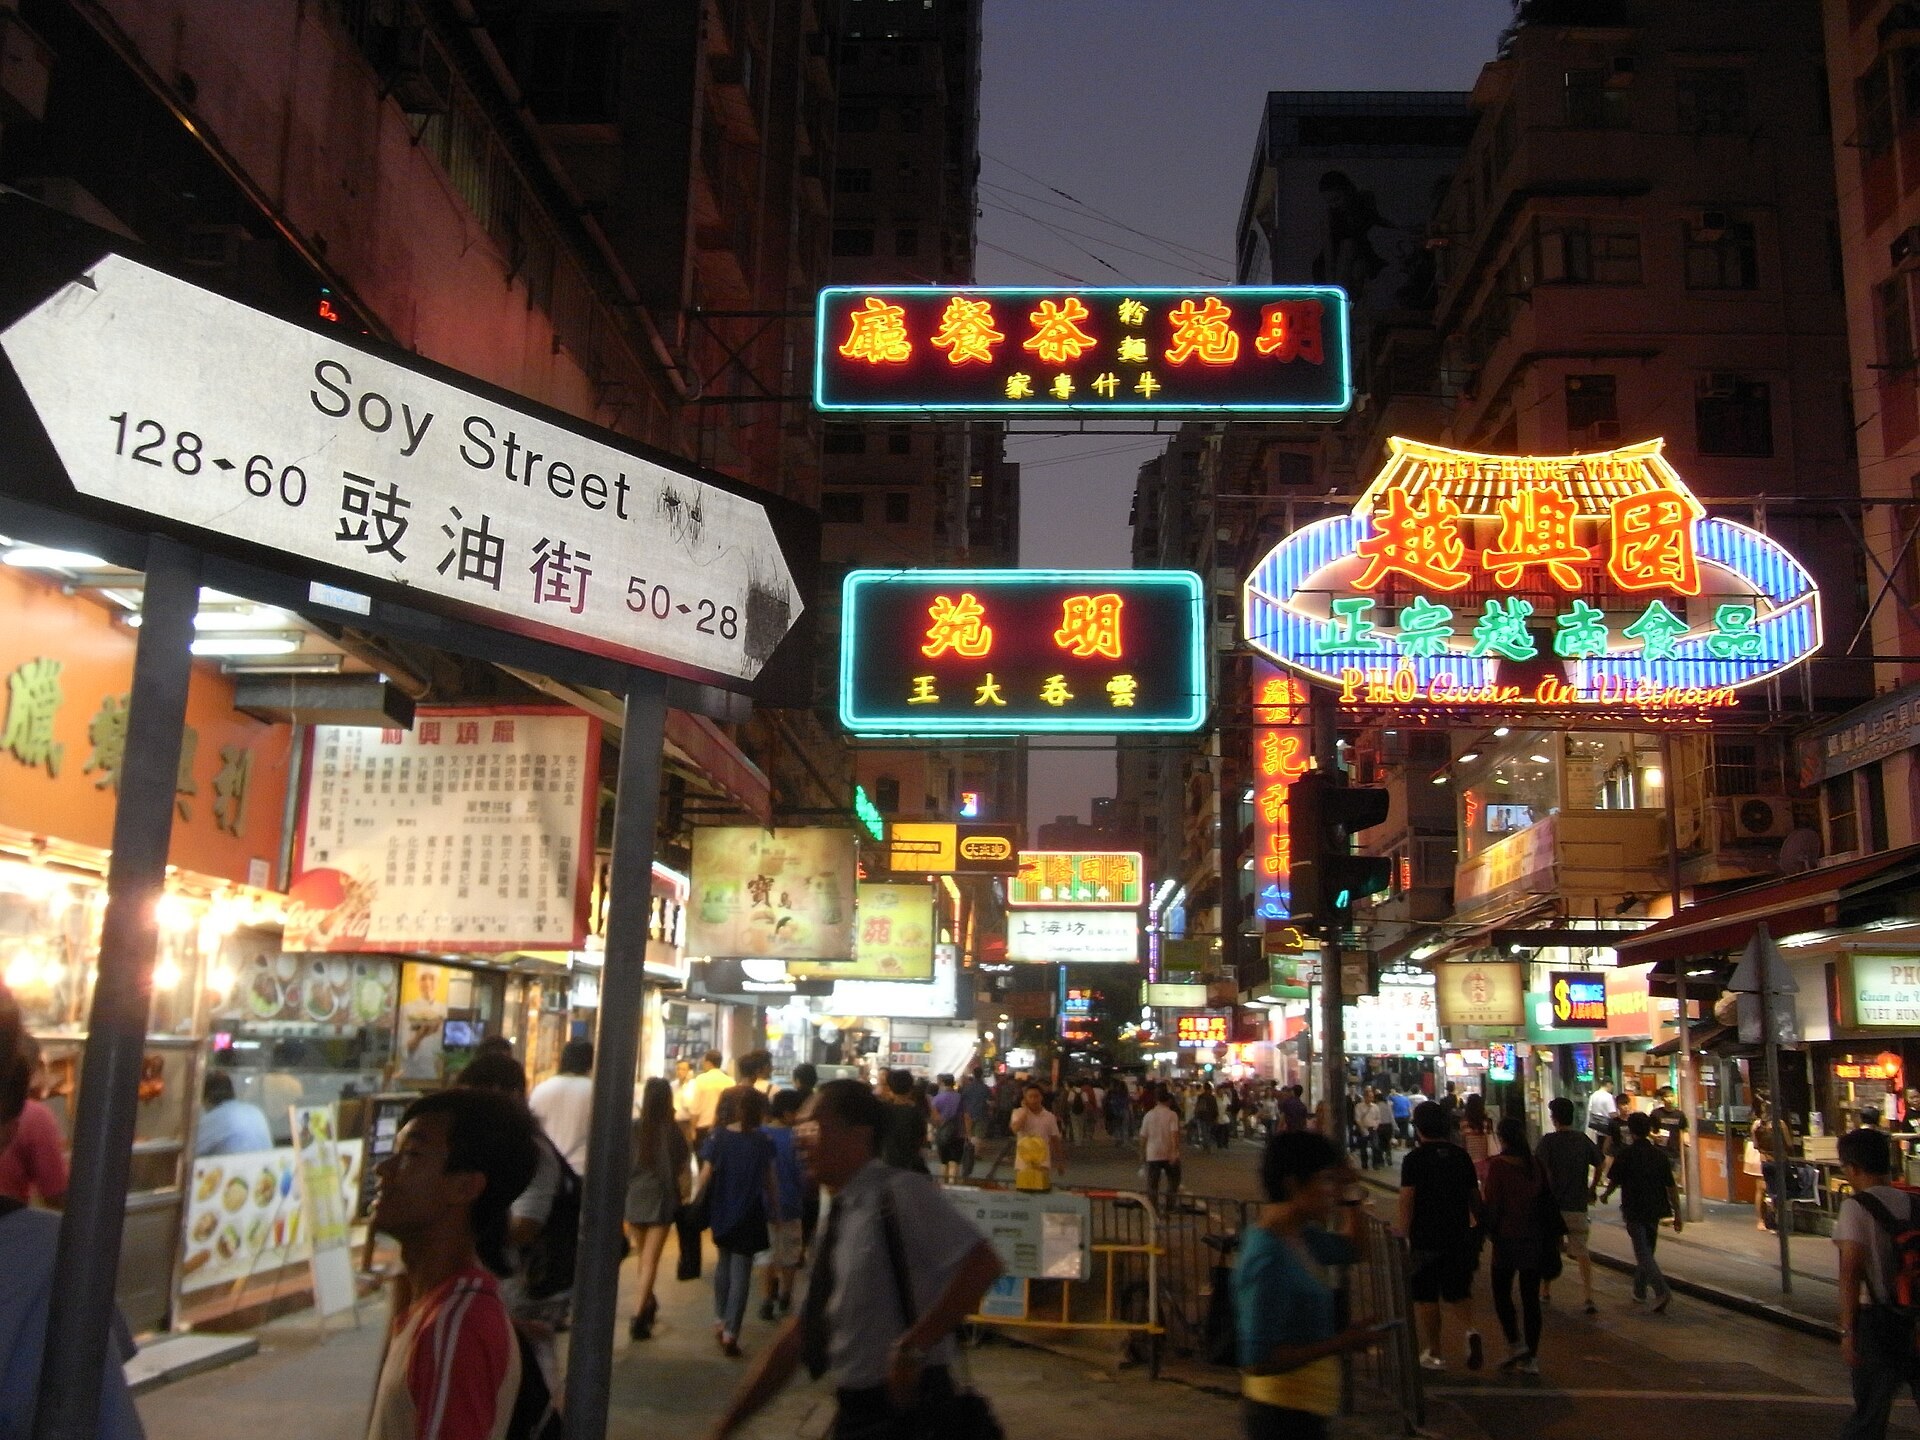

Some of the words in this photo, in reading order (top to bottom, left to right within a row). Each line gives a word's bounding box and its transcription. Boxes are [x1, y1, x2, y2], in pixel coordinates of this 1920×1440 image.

[310, 360, 434, 457] Soy
[459, 416, 631, 522] Street
[336, 471, 593, 615] 豉油街
[1314, 596, 1763, 662] 正宗越南食品
[1017, 920, 1086, 936] 上海坊
